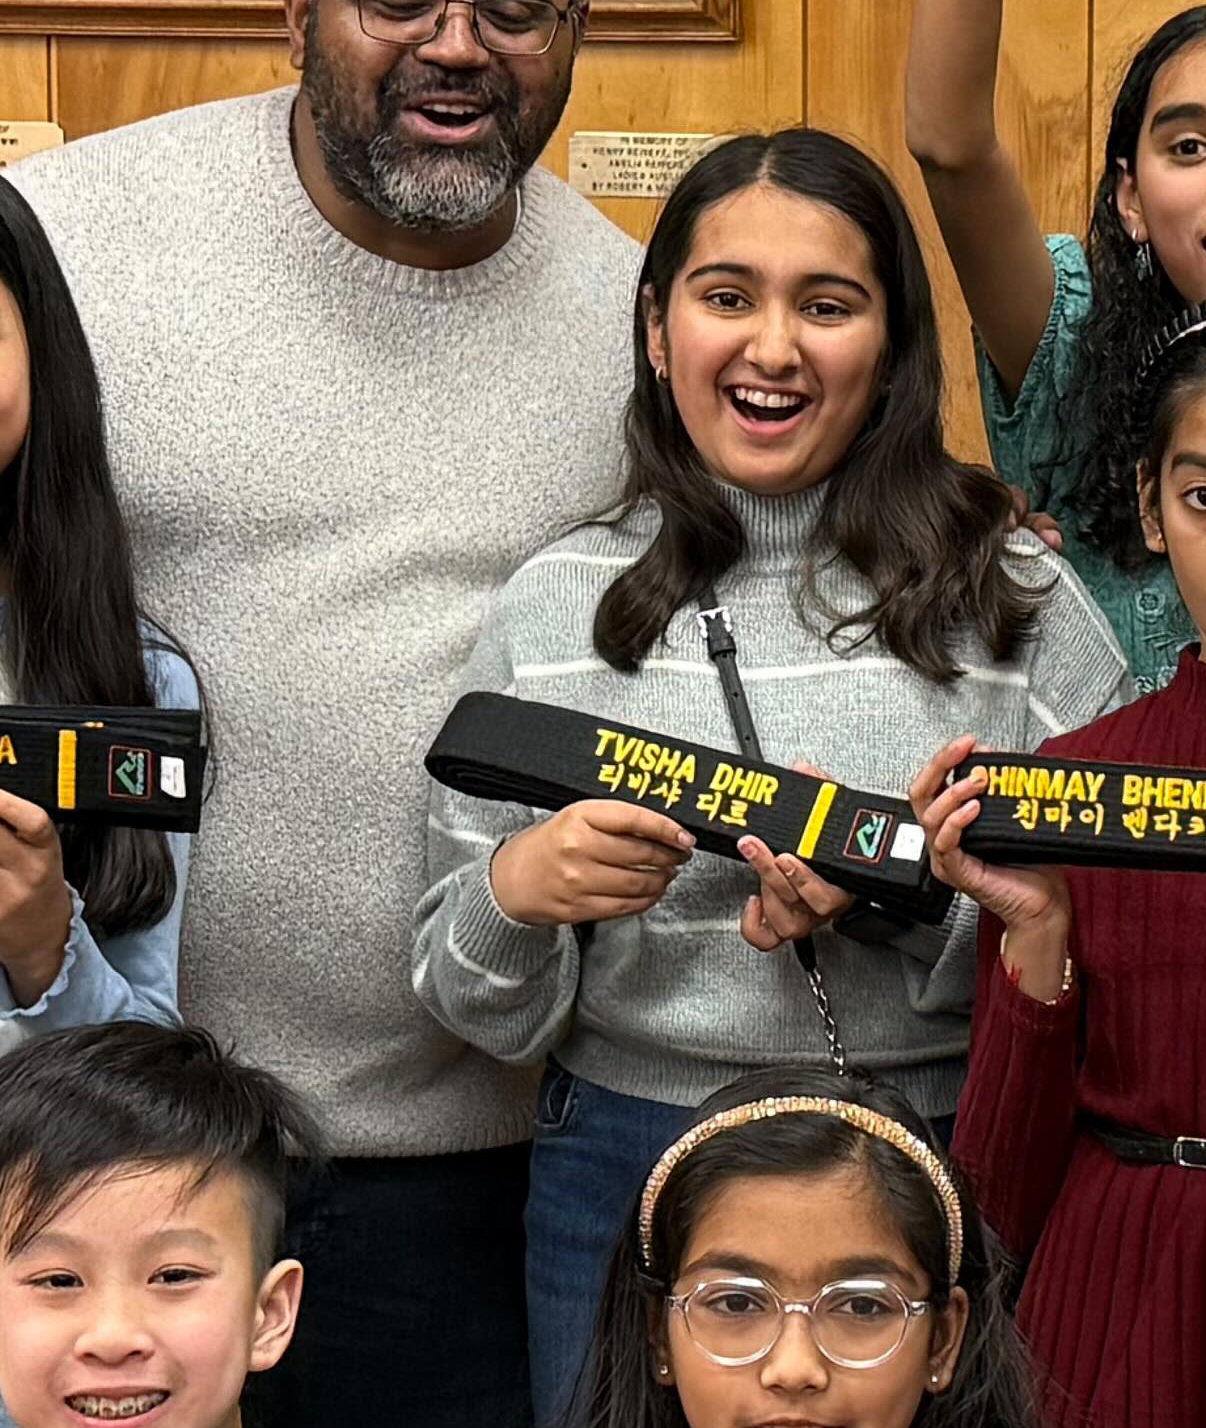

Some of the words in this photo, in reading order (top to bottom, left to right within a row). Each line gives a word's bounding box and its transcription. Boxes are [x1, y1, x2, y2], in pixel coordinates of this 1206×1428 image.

[595, 728, 697, 785] TVISHA
[709, 762, 780, 806] DHIR
[984, 765, 1107, 803] HINMAY
[695, 791, 749, 828] 디르
[1011, 798, 1106, 836] 친마이
